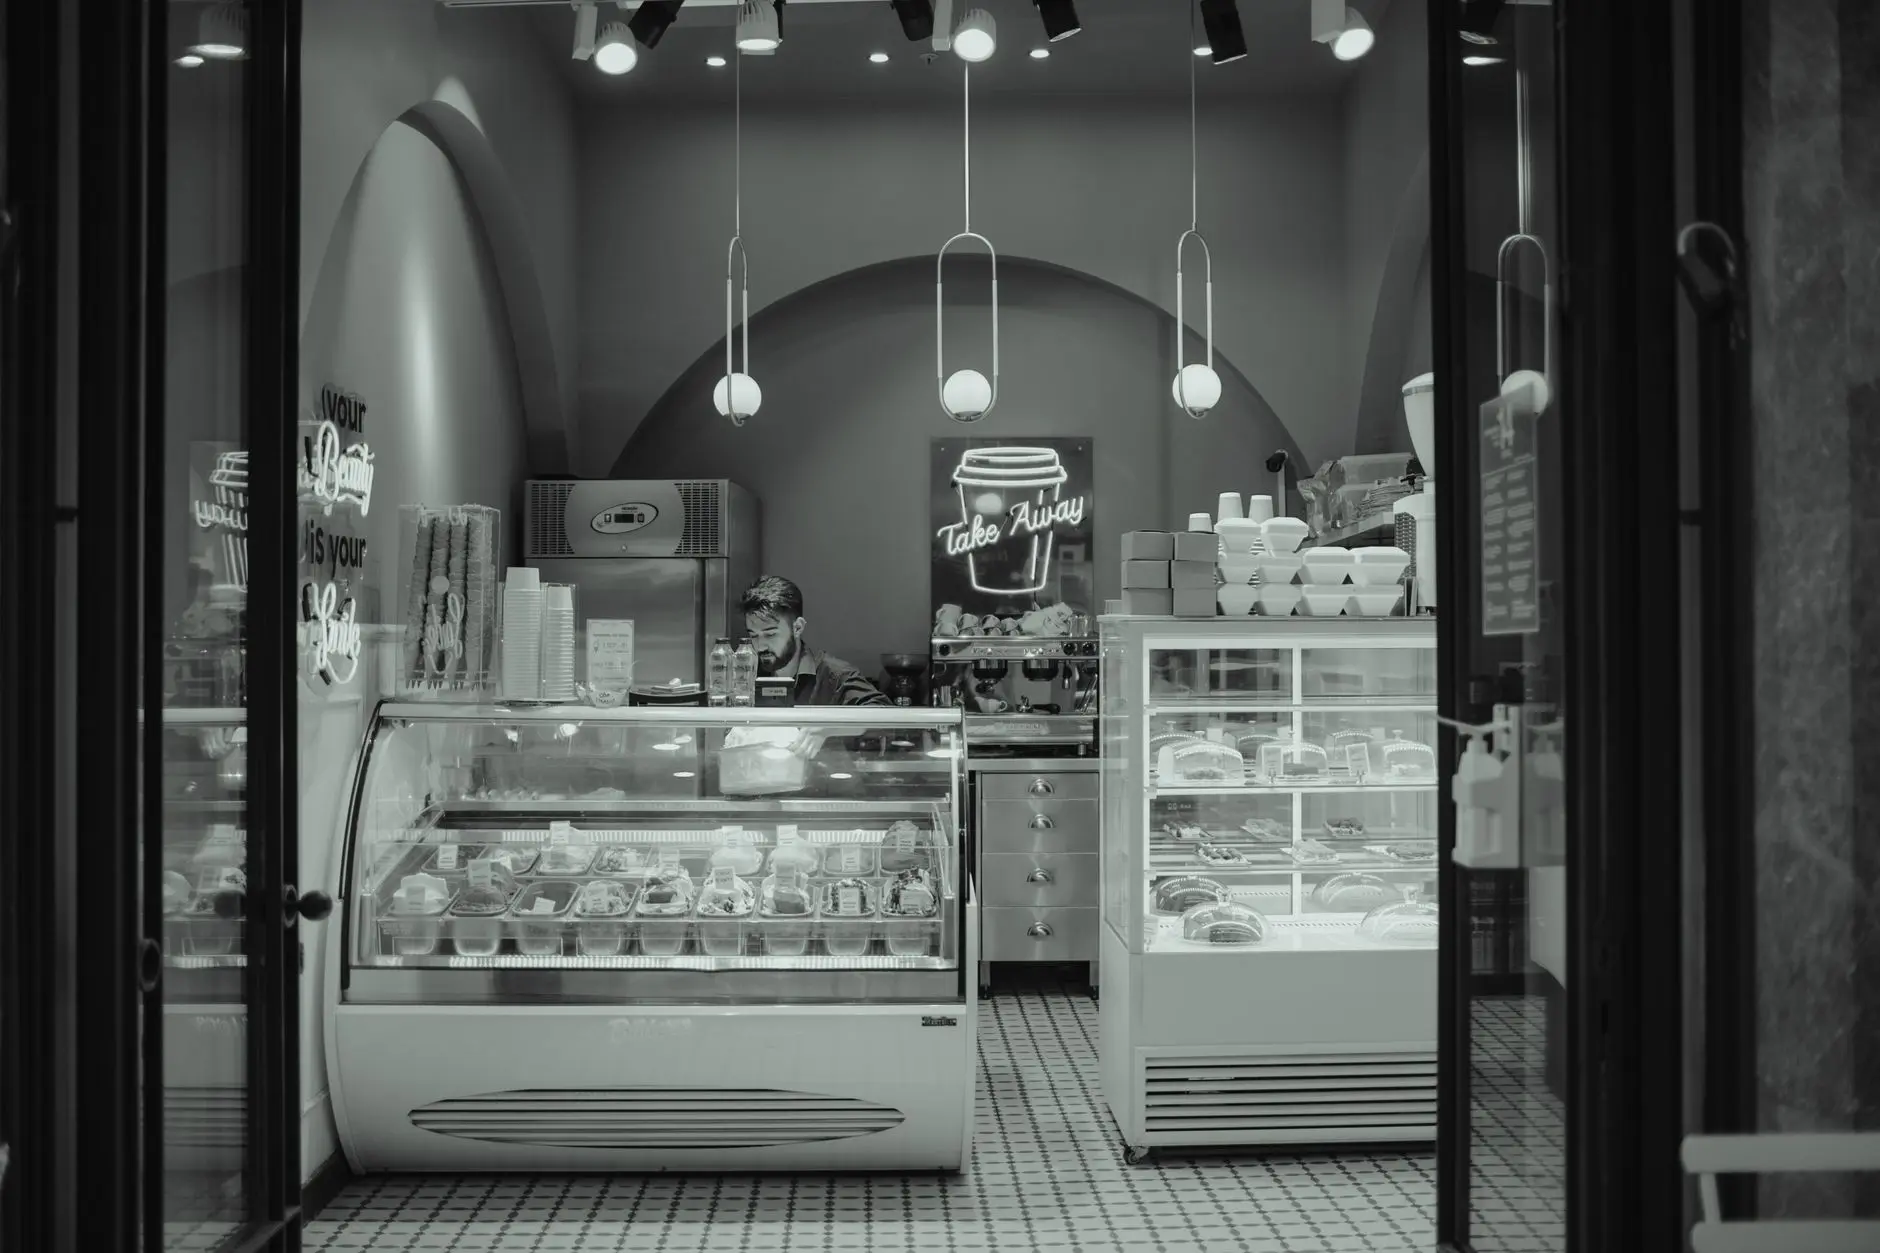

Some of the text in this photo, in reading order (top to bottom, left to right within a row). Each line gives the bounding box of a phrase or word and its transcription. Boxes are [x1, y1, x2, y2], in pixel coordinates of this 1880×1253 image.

[310, 519, 367, 578] is your
[936, 496, 1084, 556] Take Away
